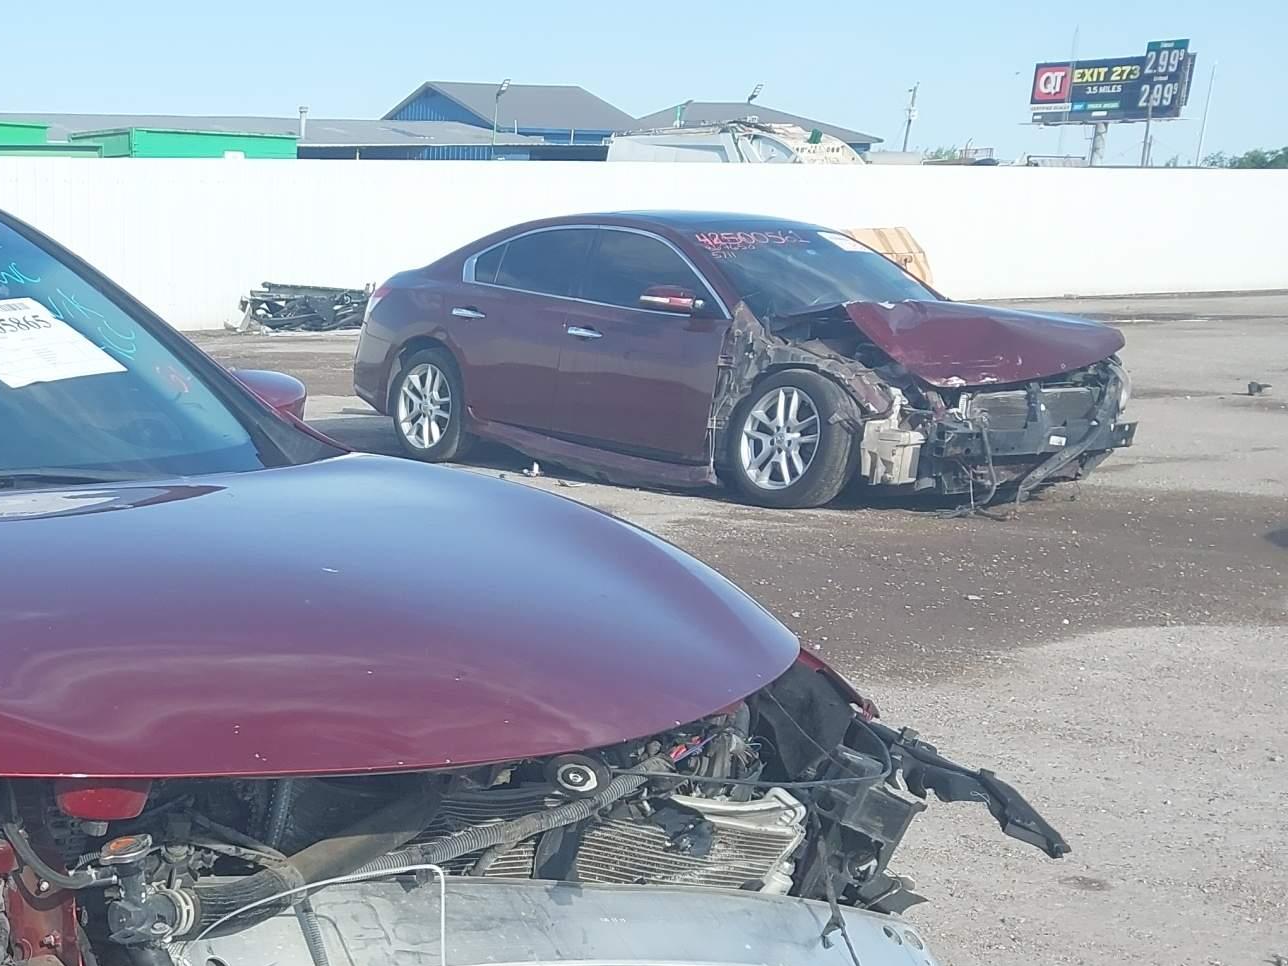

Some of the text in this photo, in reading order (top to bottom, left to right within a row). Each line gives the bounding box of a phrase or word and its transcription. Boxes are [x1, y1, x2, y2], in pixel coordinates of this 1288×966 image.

[1039, 71, 1065, 95] QT
[1072, 64, 1141, 83] EXIT 273
[1099, 84, 1122, 93] MILES
